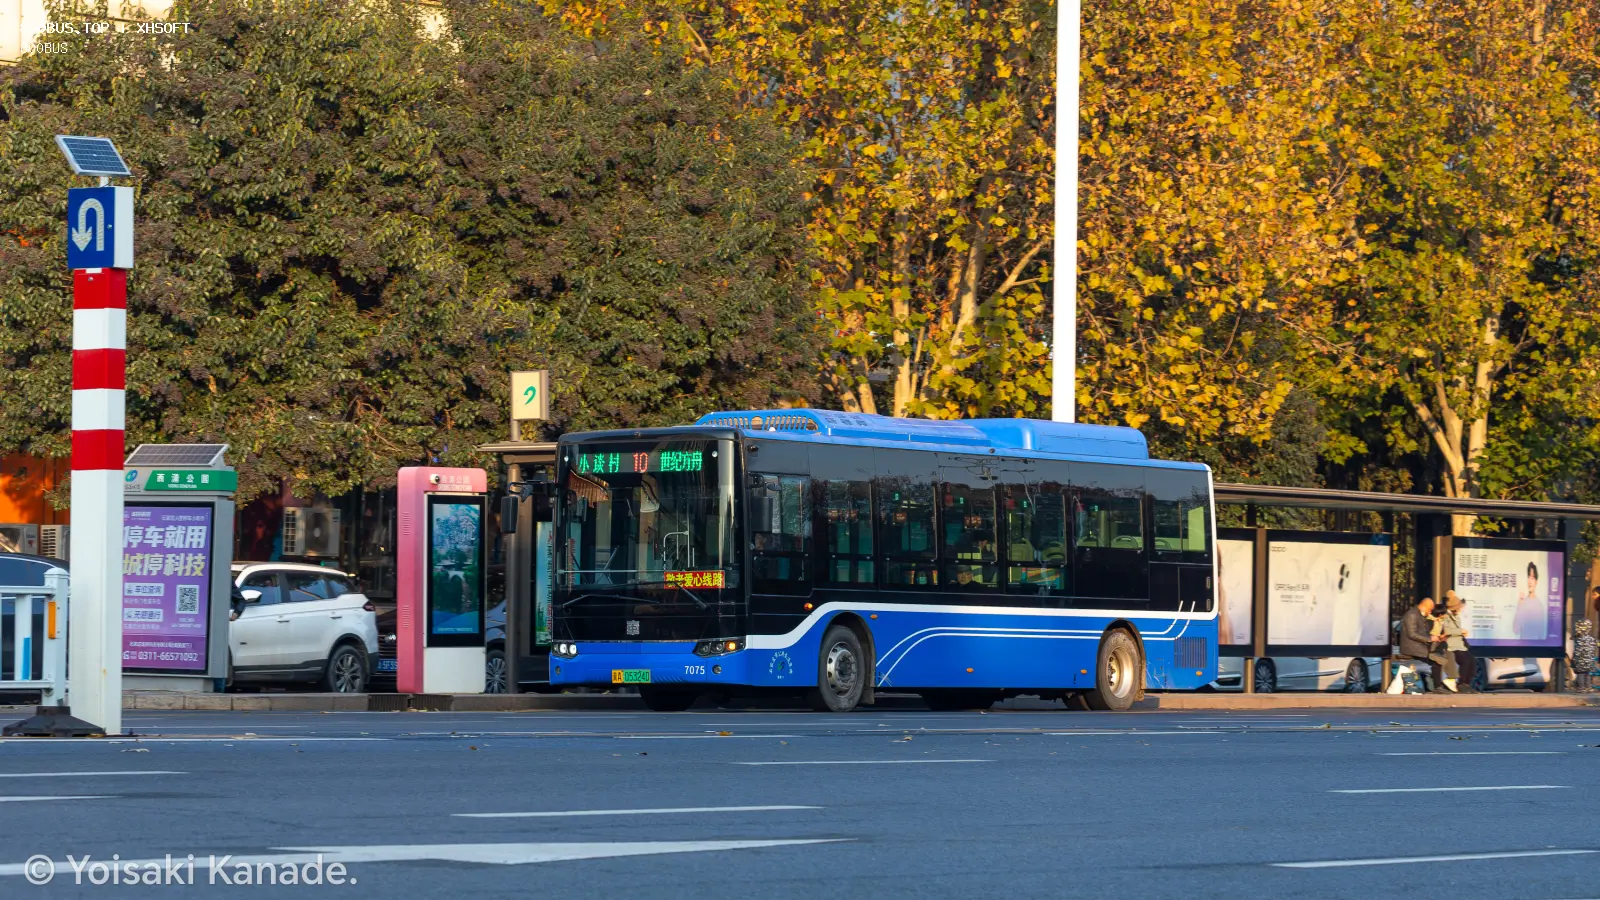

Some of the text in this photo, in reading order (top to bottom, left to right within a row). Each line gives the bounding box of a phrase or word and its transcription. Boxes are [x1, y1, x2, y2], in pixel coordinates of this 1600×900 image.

[579, 451, 703, 473] 小谈村 10 世纪方舟
[123, 525, 207, 549] 停车就用
[123, 553, 206, 577] 城停科技
[666, 572, 722, 587] 敬老爱心线路
[684, 665, 705, 675] 7075
